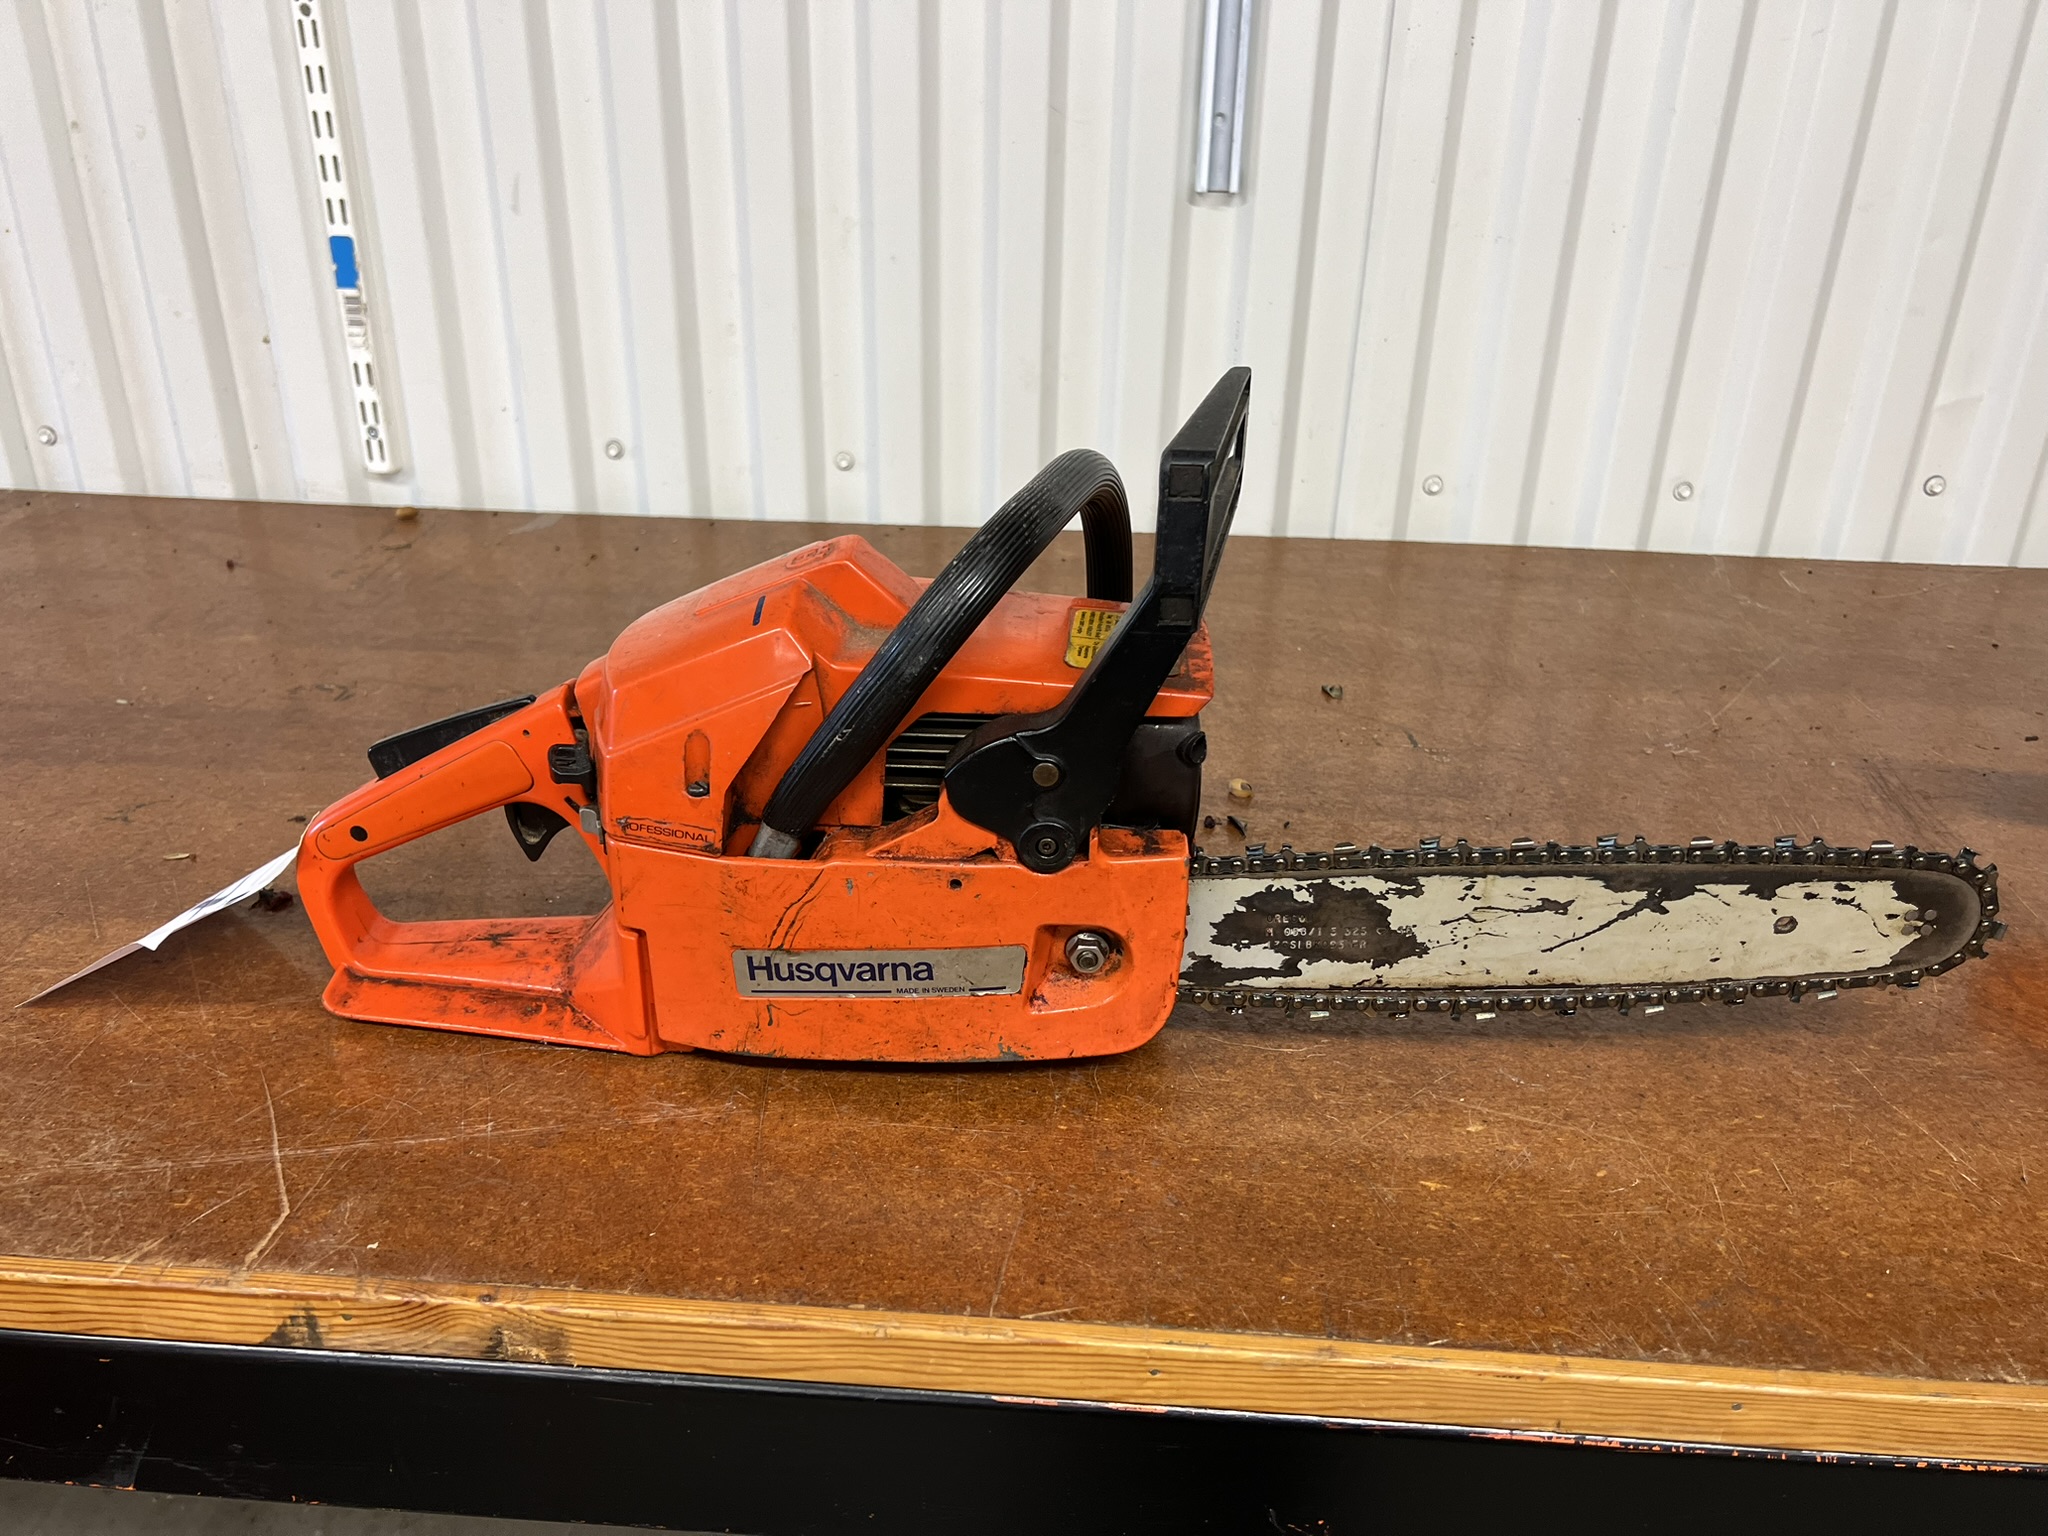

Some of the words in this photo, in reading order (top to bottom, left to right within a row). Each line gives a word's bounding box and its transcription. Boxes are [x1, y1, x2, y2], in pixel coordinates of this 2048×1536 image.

[624, 821, 709, 843] OFESSIONAL
[746, 956, 934, 986] Husqvarna
[931, 986, 965, 994] SWEDEN
